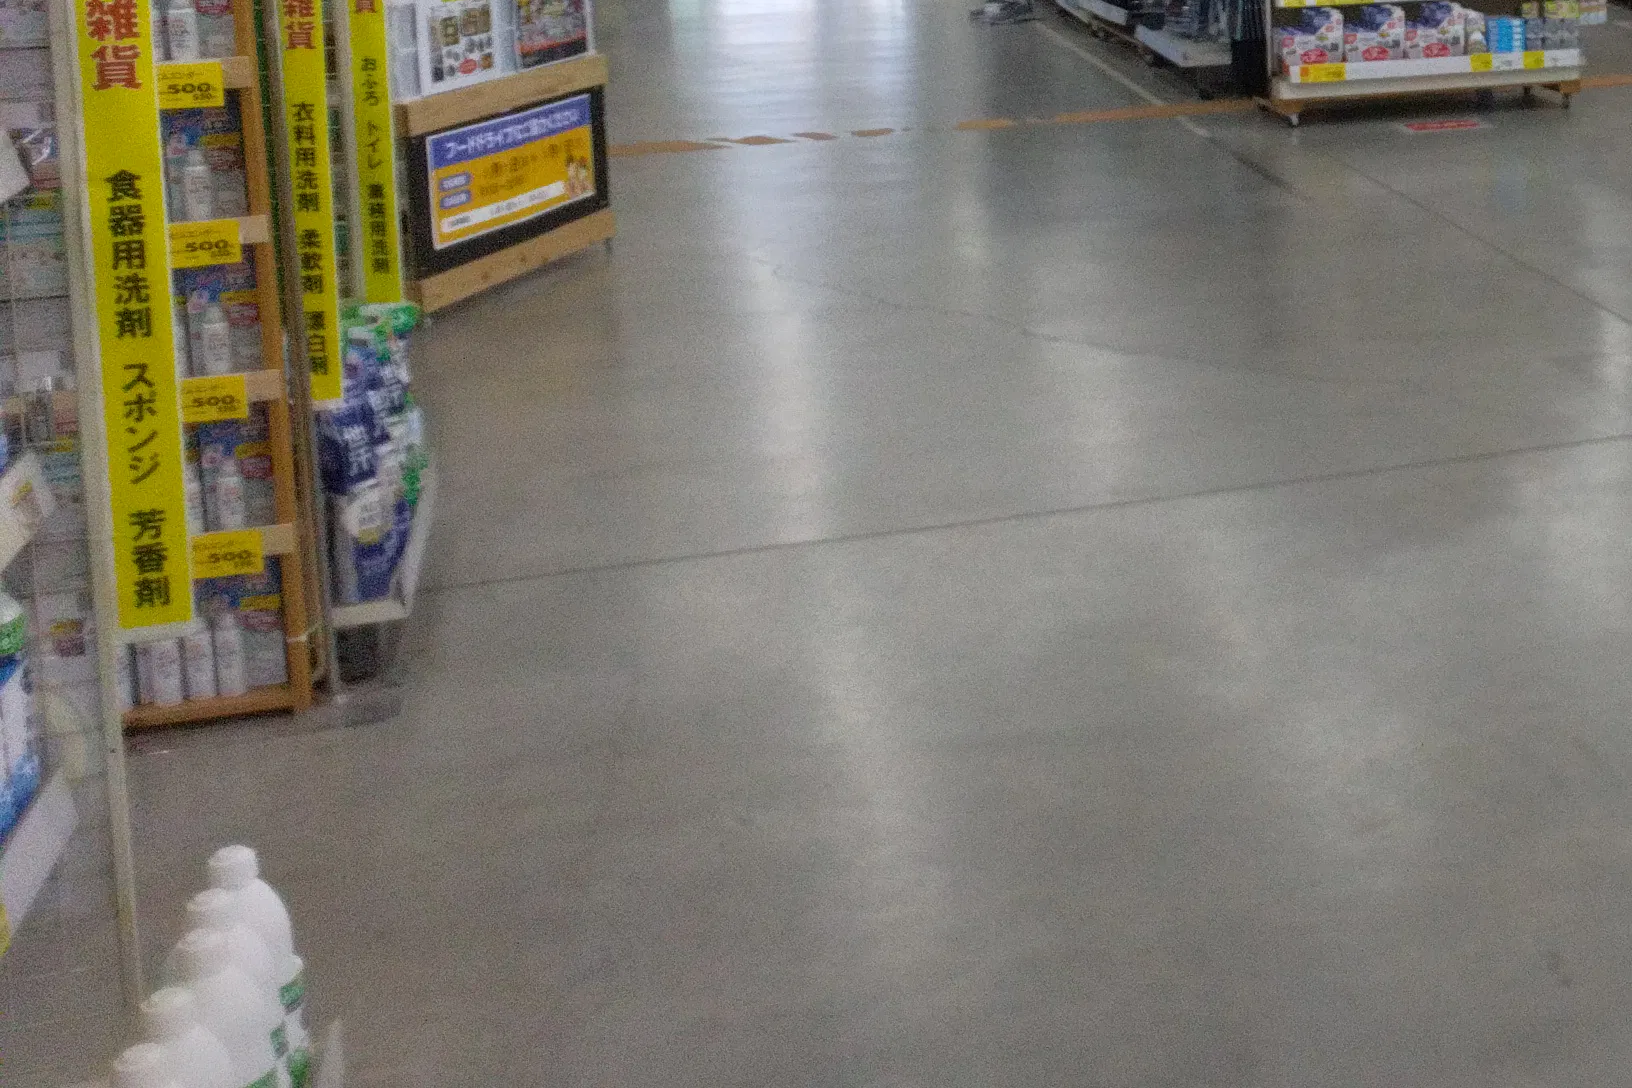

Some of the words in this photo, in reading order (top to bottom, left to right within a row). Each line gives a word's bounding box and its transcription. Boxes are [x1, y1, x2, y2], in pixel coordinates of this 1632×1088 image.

[167, 82, 211, 94] 500
[104, 169, 152, 339] 食器用洗剤
[185, 238, 229, 252] 500
[122, 363, 160, 485] スポンジ
[192, 394, 235, 408] 500
[129, 509, 171, 608] 芳香剤
